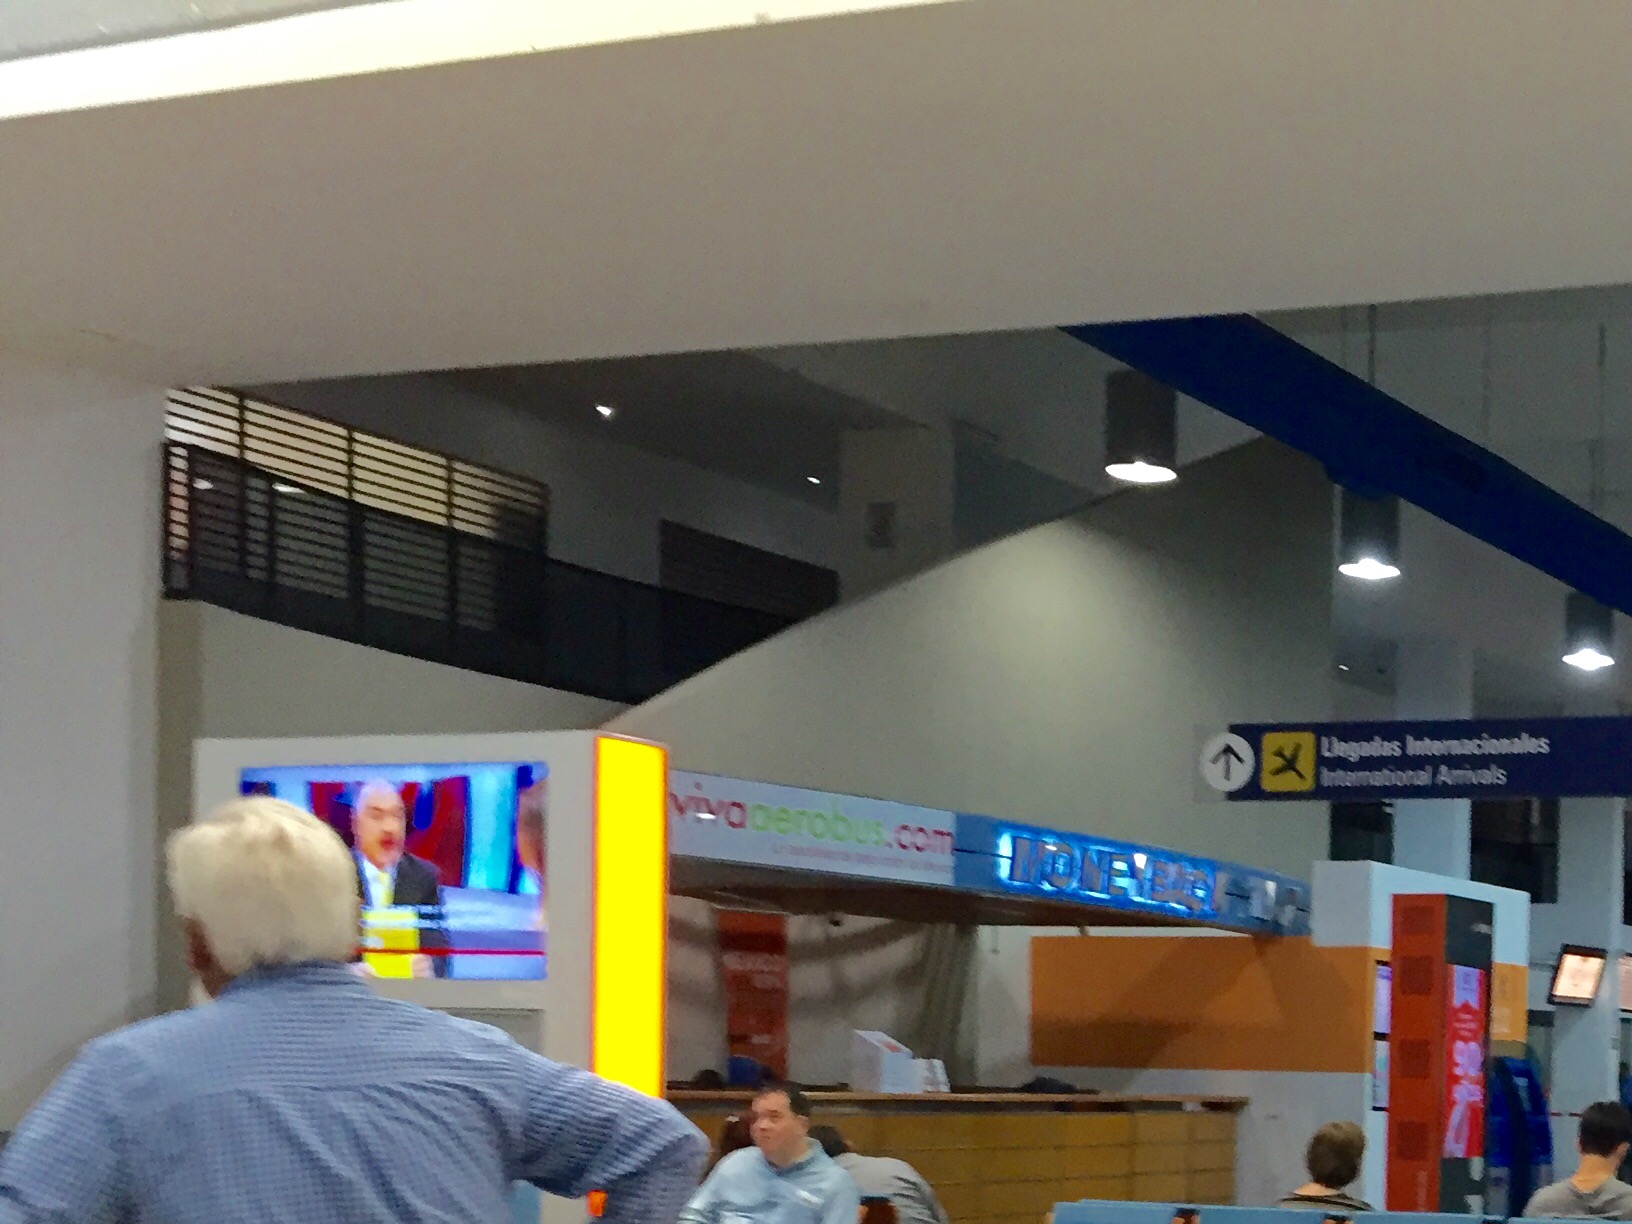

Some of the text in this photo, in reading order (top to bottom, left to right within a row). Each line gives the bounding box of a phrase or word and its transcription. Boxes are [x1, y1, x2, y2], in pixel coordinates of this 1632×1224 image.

[1320, 732, 1551, 762] Llegadas Internacionales
[1319, 763, 1508, 787] International Arrivals
